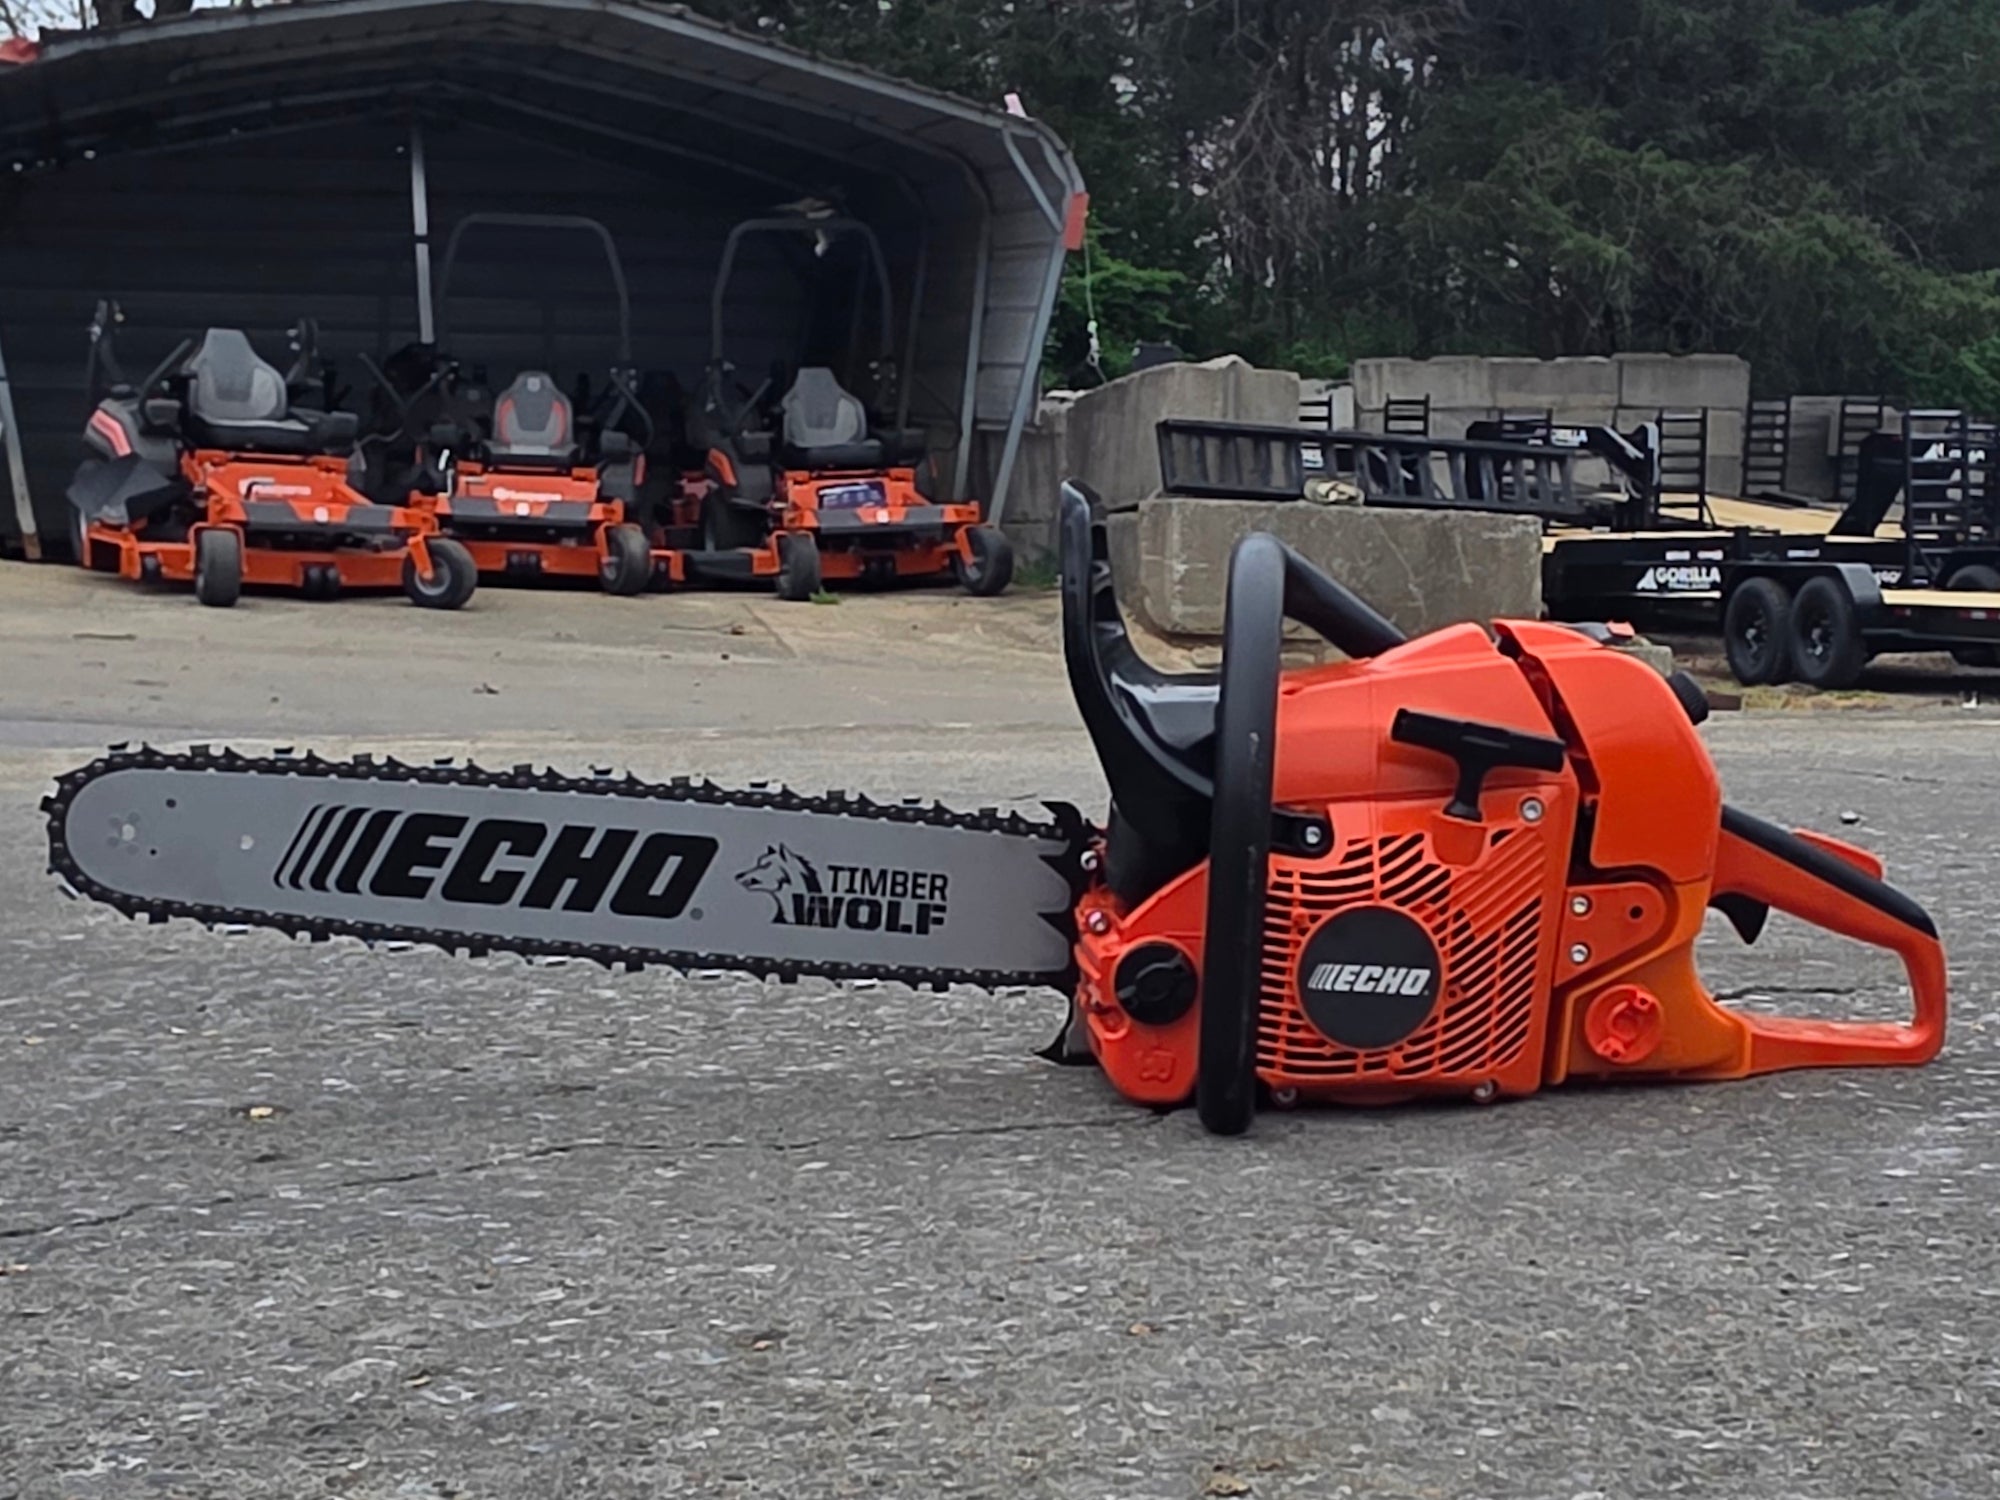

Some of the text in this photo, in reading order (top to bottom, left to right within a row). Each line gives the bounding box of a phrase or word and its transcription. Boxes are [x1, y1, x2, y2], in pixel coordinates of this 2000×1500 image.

[368, 812, 719, 919] ECHO
[826, 864, 949, 902] TIMBER
[791, 893, 948, 935] WOLF
[1332, 964, 1431, 996] ECHO
